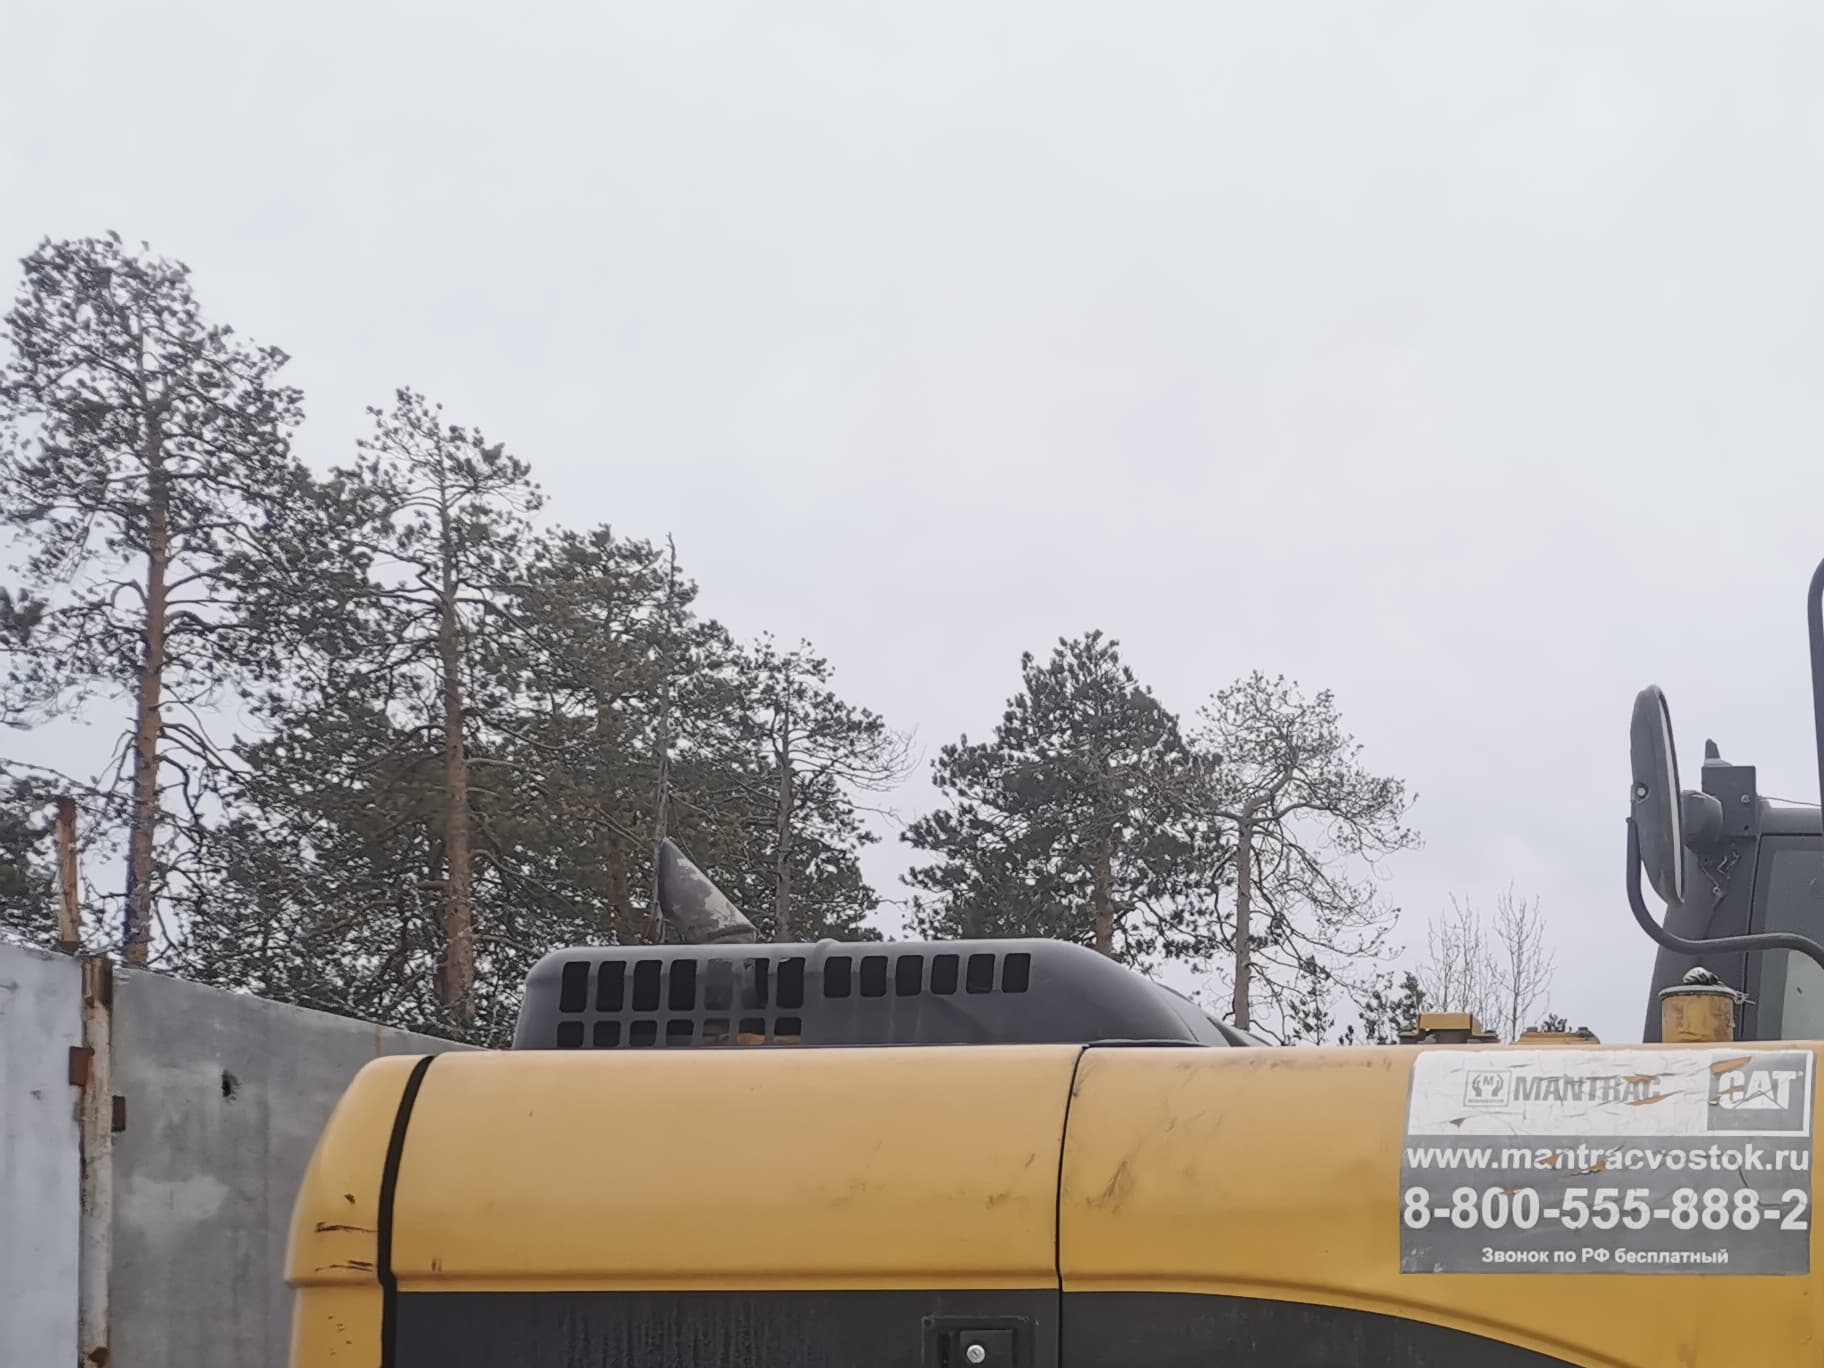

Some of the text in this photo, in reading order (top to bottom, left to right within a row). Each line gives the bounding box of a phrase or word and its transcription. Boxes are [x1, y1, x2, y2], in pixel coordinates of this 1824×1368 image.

[1718, 1070, 1797, 1110] CAT
[1407, 1144, 1809, 1171] www.mantracvostok.ru
[1403, 1186, 1808, 1231] 8-800-555-888-2
[1481, 1247, 1729, 1264] Звонок по РФ бесплатный
